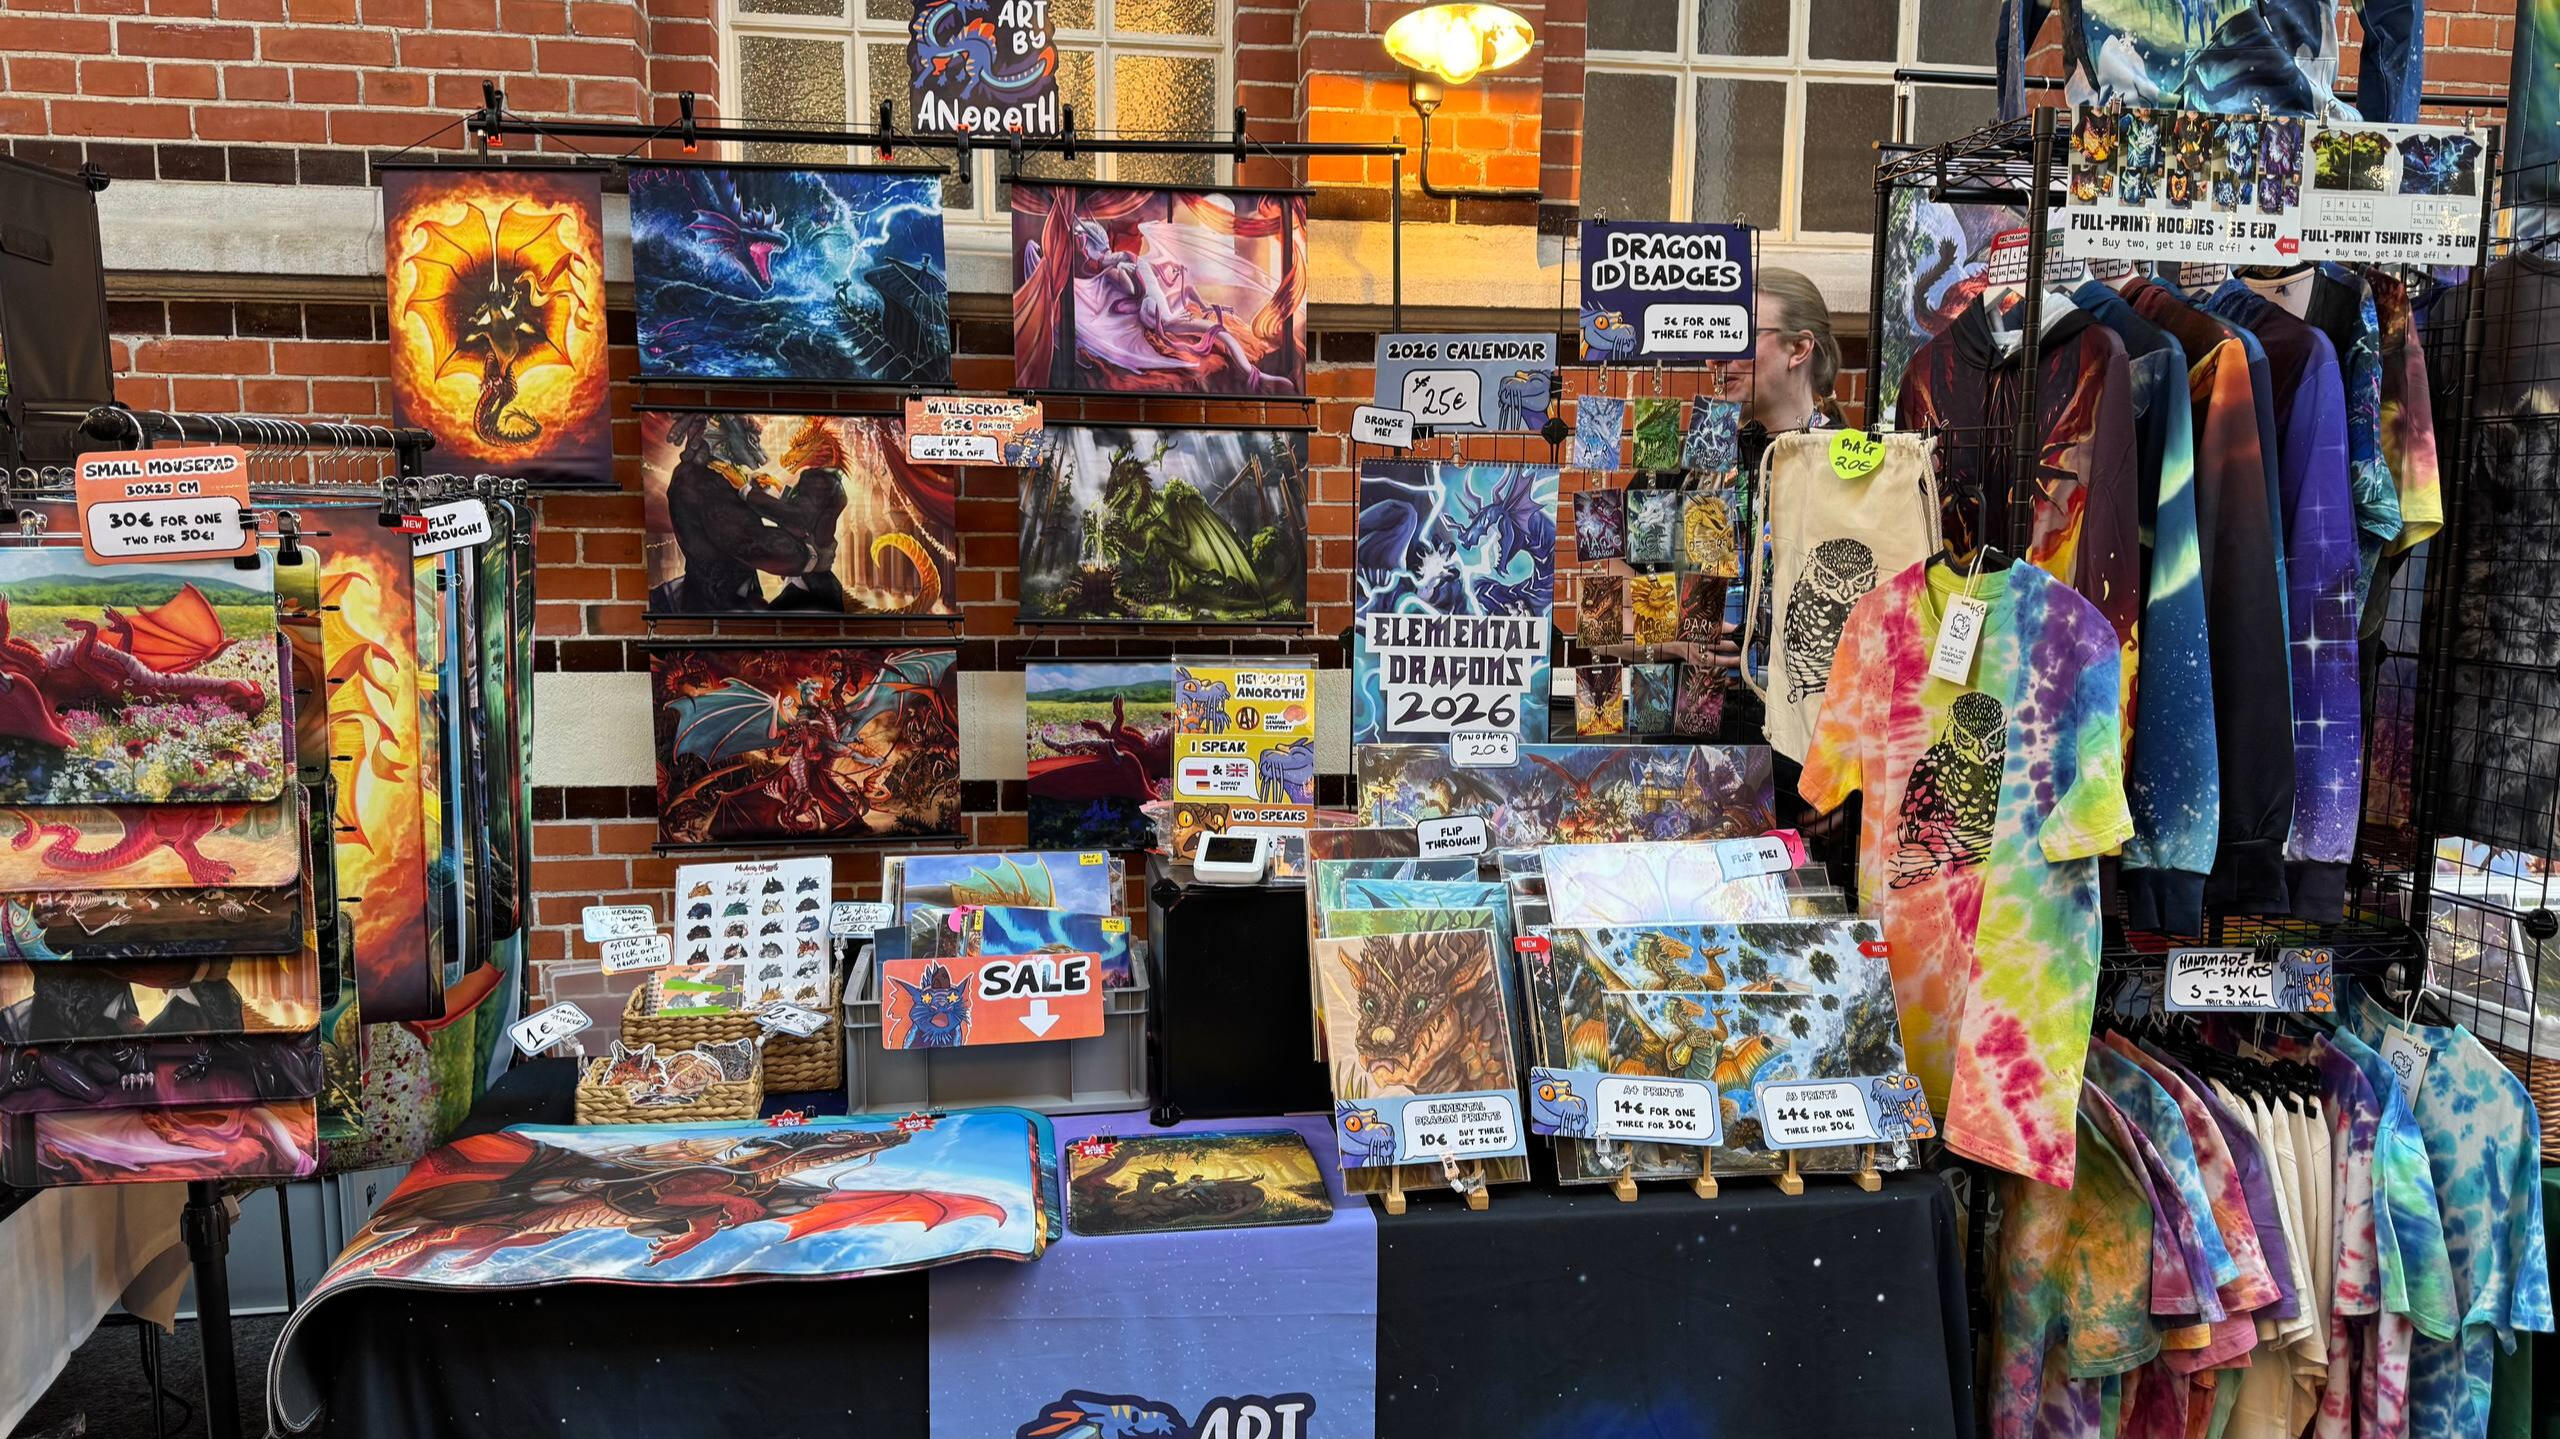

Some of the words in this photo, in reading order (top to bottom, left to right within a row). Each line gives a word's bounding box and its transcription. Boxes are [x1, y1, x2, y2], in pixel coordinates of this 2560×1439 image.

[998, 0, 1047, 29] ART
[1013, 30, 1045, 55] BY
[918, 90, 1055, 135] ANOROTH
[2071, 213, 2150, 232] FULL-PRINT
[2156, 216, 2214, 236] HOODIES
[2251, 222, 2277, 239] EUR
[2102, 238, 2120, 249] Buy
[2127, 238, 2149, 250] two,
[2156, 241, 2174, 250] get
[2179, 240, 2191, 249] 10
[2196, 241, 2214, 251] EUR
[2301, 229, 2371, 243] FULL-PRINT
[2375, 231, 2423, 245] TSHIRTS
[2437, 234, 2452, 247] 35
[2455, 236, 2477, 248] EUR
[1612, 237, 1721, 260] DRAGON
[2335, 248, 2349, 258] Buy
[2354, 249, 2371, 259] two,
[2376, 250, 2389, 259] get
[2393, 250, 2402, 258] 10
[2407, 250, 2420, 258] EUR
[1597, 266, 1621, 286] ID
[1634, 264, 1737, 287] BADGES
[1664, 316, 1678, 326] 5€
[1683, 316, 1704, 326] FOR
[1709, 316, 1731, 326] ONE
[1652, 329, 1688, 339] THREE
[1693, 330, 1714, 339] FOR
[1720, 330, 1743, 340] 12€!
[1387, 343, 1438, 359] 2026
[1446, 343, 1546, 360] CALENDAR
[1422, 387, 1467, 416] 25€
[1365, 415, 1404, 428] BROWSE
[1374, 426, 1392, 438] ME!
[924, 449, 944, 457] GET
[1841, 438, 1878, 456] BAG
[85, 463, 141, 477] SMALL
[148, 457, 235, 474] MOUSEPAD
[1834, 456, 1872, 472] 20€
[126, 483, 172, 495] 30X25
[178, 482, 199, 493] CM
[109, 512, 153, 529] 30€
[161, 514, 188, 527] FOR
[195, 512, 222, 524] ONE
[402, 520, 422, 529] NEW
[428, 513, 457, 530] FLIP
[122, 535, 148, 545] TWO
[154, 534, 176, 544] FOR
[181, 529, 215, 542] 50€!
[413, 522, 482, 547] THROUGH!
[1374, 616, 1540, 652] ELEMENTAL
[1388, 655, 1523, 691] DRAGONS
[1237, 687, 1305, 699] ANOROTH!
[1394, 692, 1516, 728] 2026
[1192, 742, 1196, 752] I
[1202, 741, 1246, 753] SPEAK
[1233, 810, 1256, 820] WYO
[1261, 811, 1306, 821] SPEAKS
[1440, 826, 1463, 837] FLIP
[1425, 836, 1480, 850] THROUGH!
[1731, 852, 1754, 864] FLIP
[1758, 849, 1778, 860] ME!
[1522, 940, 1537, 948] NEW
[2180, 953, 2251, 969] HANDMADE
[983, 960, 1086, 996] SALE
[2203, 964, 2272, 979] T-SHIRTS
[2191, 984, 2201, 999] S
[1623, 1085, 1639, 1095] A4
[1643, 1086, 1684, 1098] PRINTS
[1801, 1089, 1838, 1101] PRINTS
[1428, 1102, 1486, 1114] ELEMENTAL
[1614, 1100, 1644, 1114] 14€
[1650, 1107, 1670, 1116] FOR
[1675, 1108, 1696, 1117] ONE
[1777, 1107, 1809, 1121] 24€
[1814, 1110, 1832, 1120] FOR
[1836, 1108, 1855, 1118] ONE
[1415, 1114, 1458, 1126] DRAGON
[1461, 1111, 1501, 1123] PRINTS
[1616, 1120, 1644, 1128] THREE
[1668, 1120, 1696, 1131] 30€!
[1478, 1127, 1504, 1135] THREE
[1784, 1126, 1809, 1135] THREE
[1812, 1125, 1827, 1133] FOR
[1830, 1121, 1855, 1131] 50€!
[1420, 1134, 1447, 1146] 10€
[1200, 1403, 1305, 1439] ART
